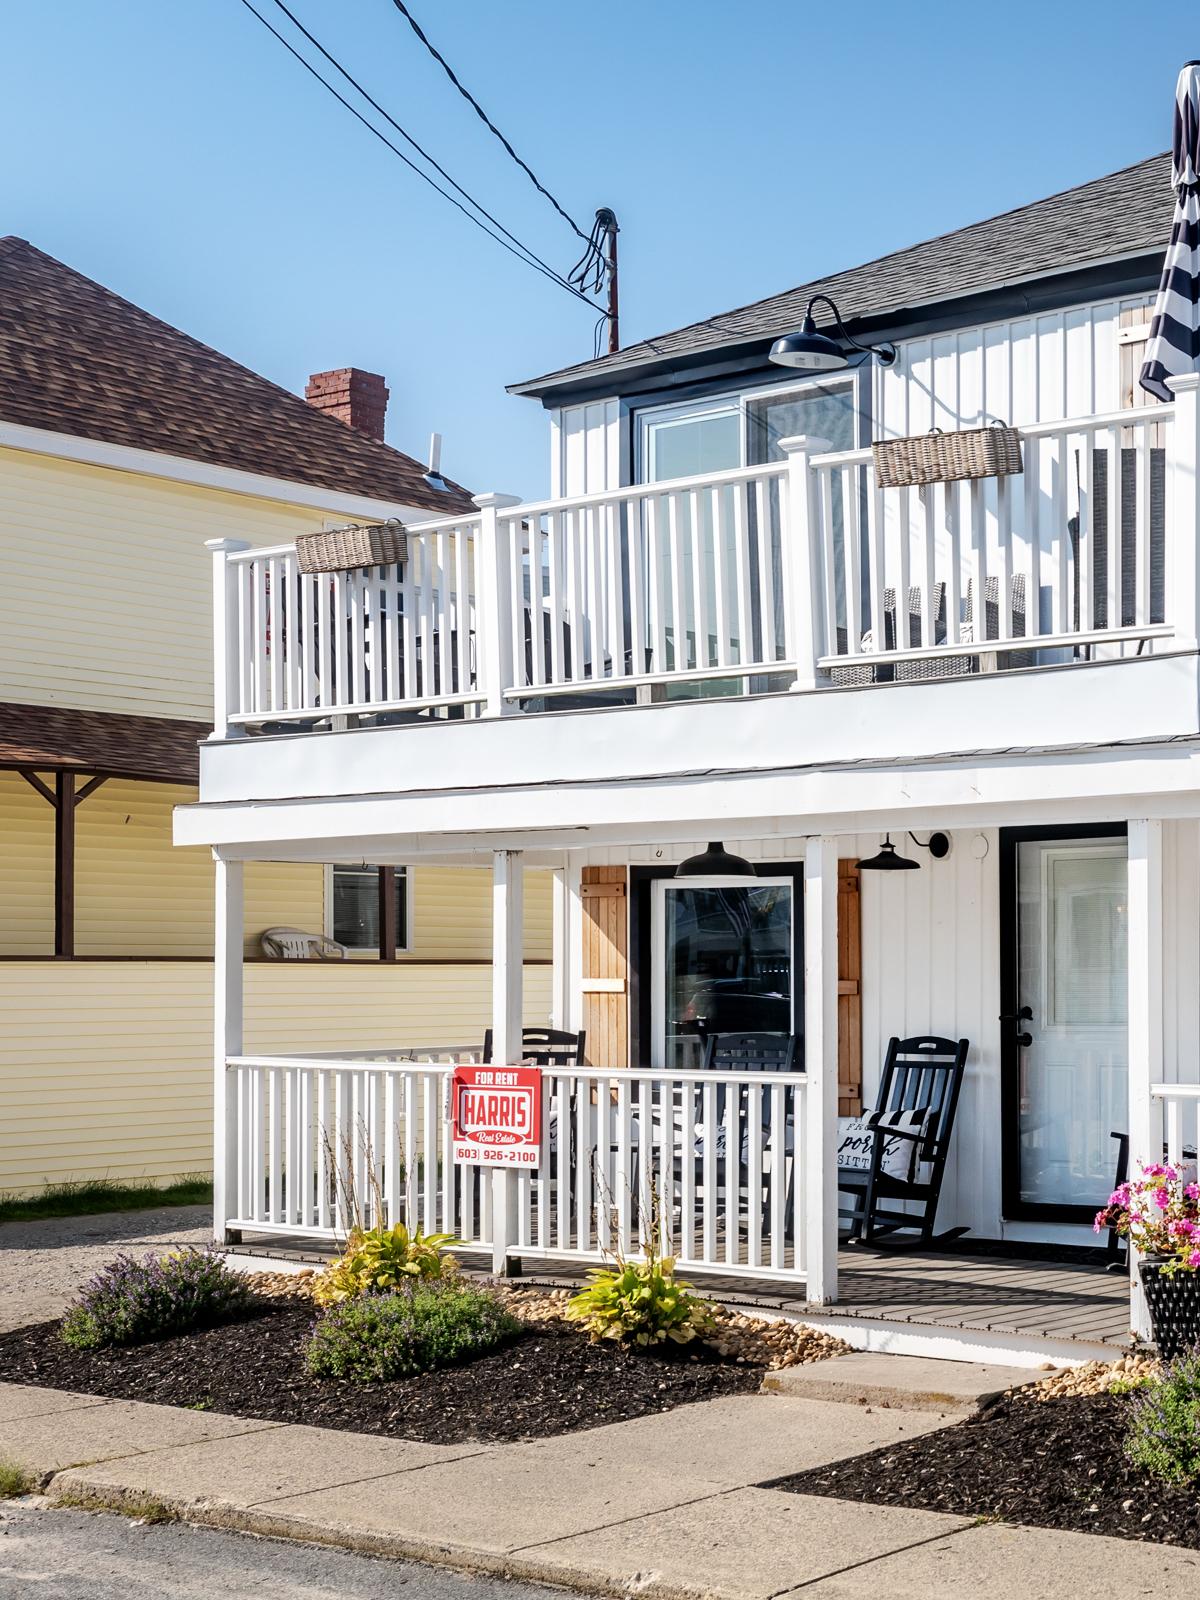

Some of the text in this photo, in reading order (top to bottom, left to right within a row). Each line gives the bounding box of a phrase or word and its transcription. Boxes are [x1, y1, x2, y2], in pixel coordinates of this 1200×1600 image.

[475, 1071, 519, 1086] FOR RENT
[465, 1095, 526, 1127] HARRIS
[476, 1131, 517, 1144] Real Estate
[456, 1147, 536, 1162] (603) 926-2100
